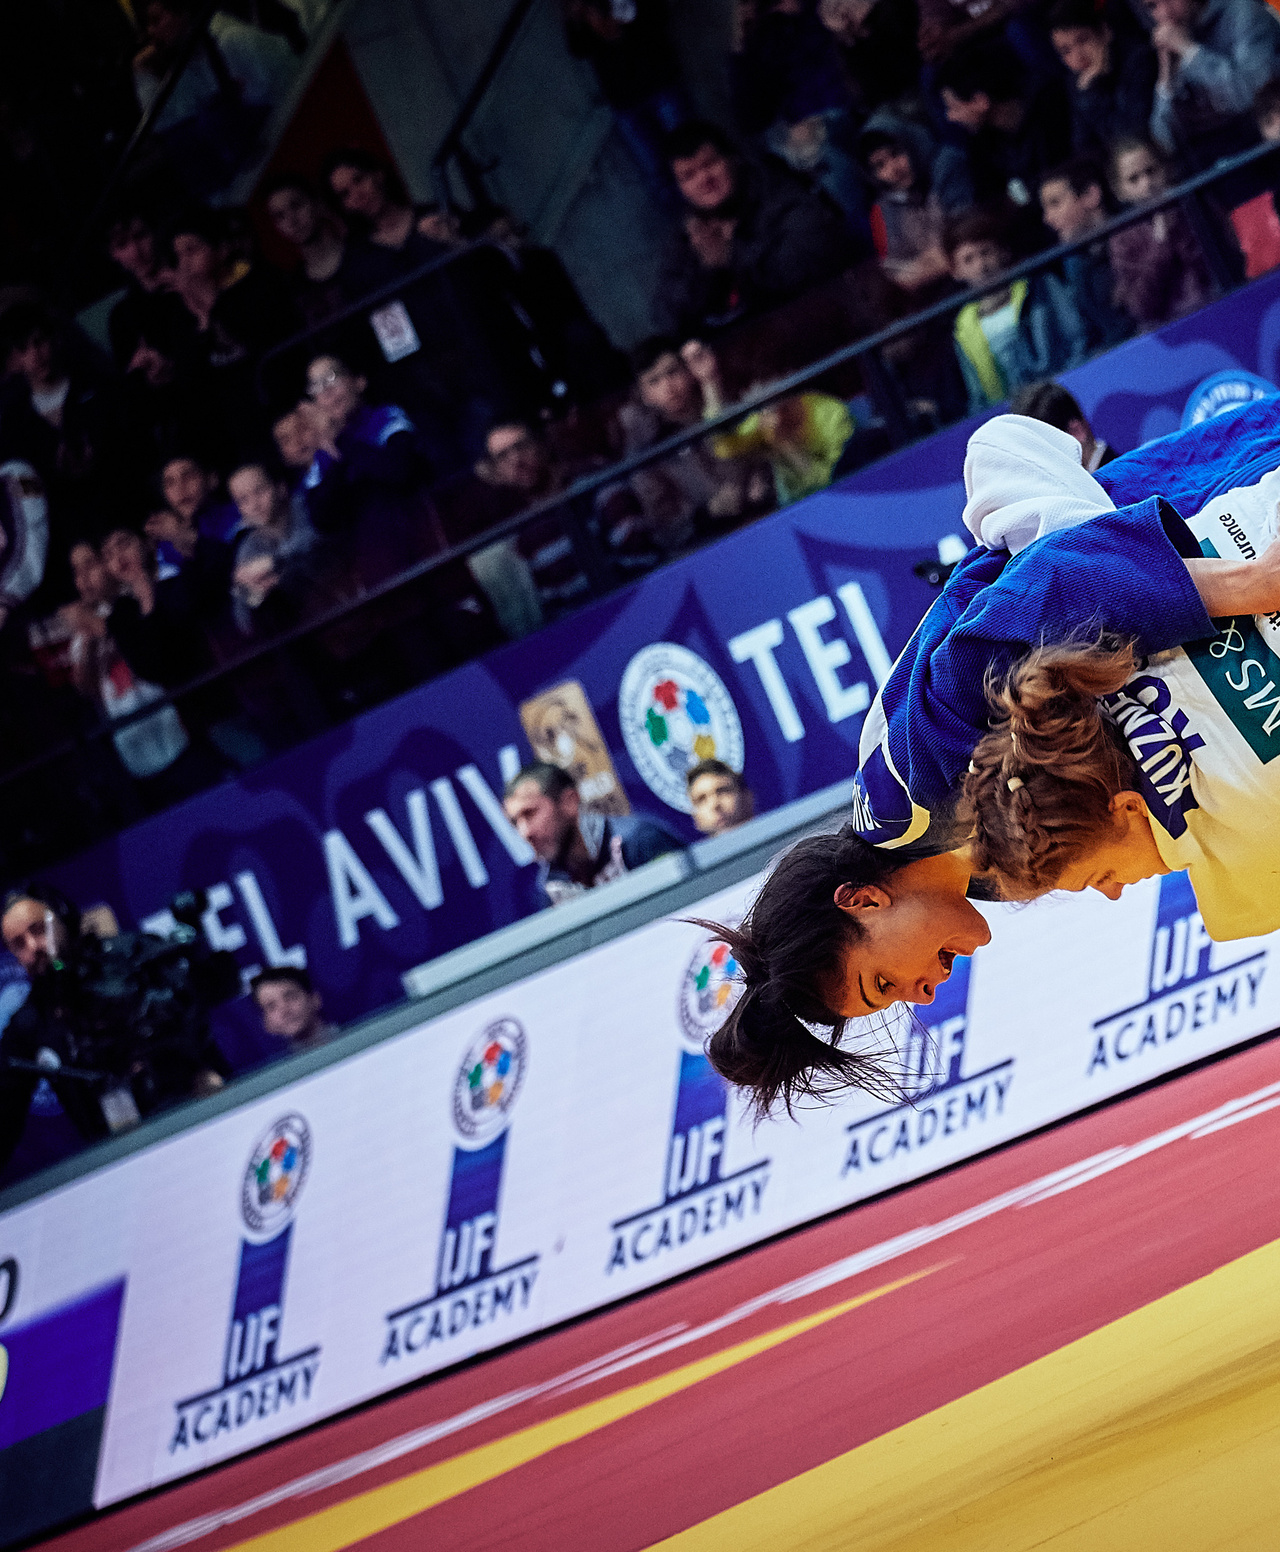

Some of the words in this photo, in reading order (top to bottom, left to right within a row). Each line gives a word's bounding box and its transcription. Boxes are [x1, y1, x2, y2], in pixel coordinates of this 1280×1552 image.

[1218, 512, 1258, 561] urance
[1150, 911, 1212, 993] IJF
[1086, 967, 1266, 1077] ACADEMY
[667, 1115, 726, 1198] IJF
[841, 1073, 1014, 1180] ACADEMY
[439, 1211, 497, 1291] IJF
[605, 1174, 771, 1276] ACADEMY
[227, 1303, 281, 1383] IJF
[379, 1270, 540, 1367] ACADEMY
[168, 1361, 321, 1456] ACADEMY
